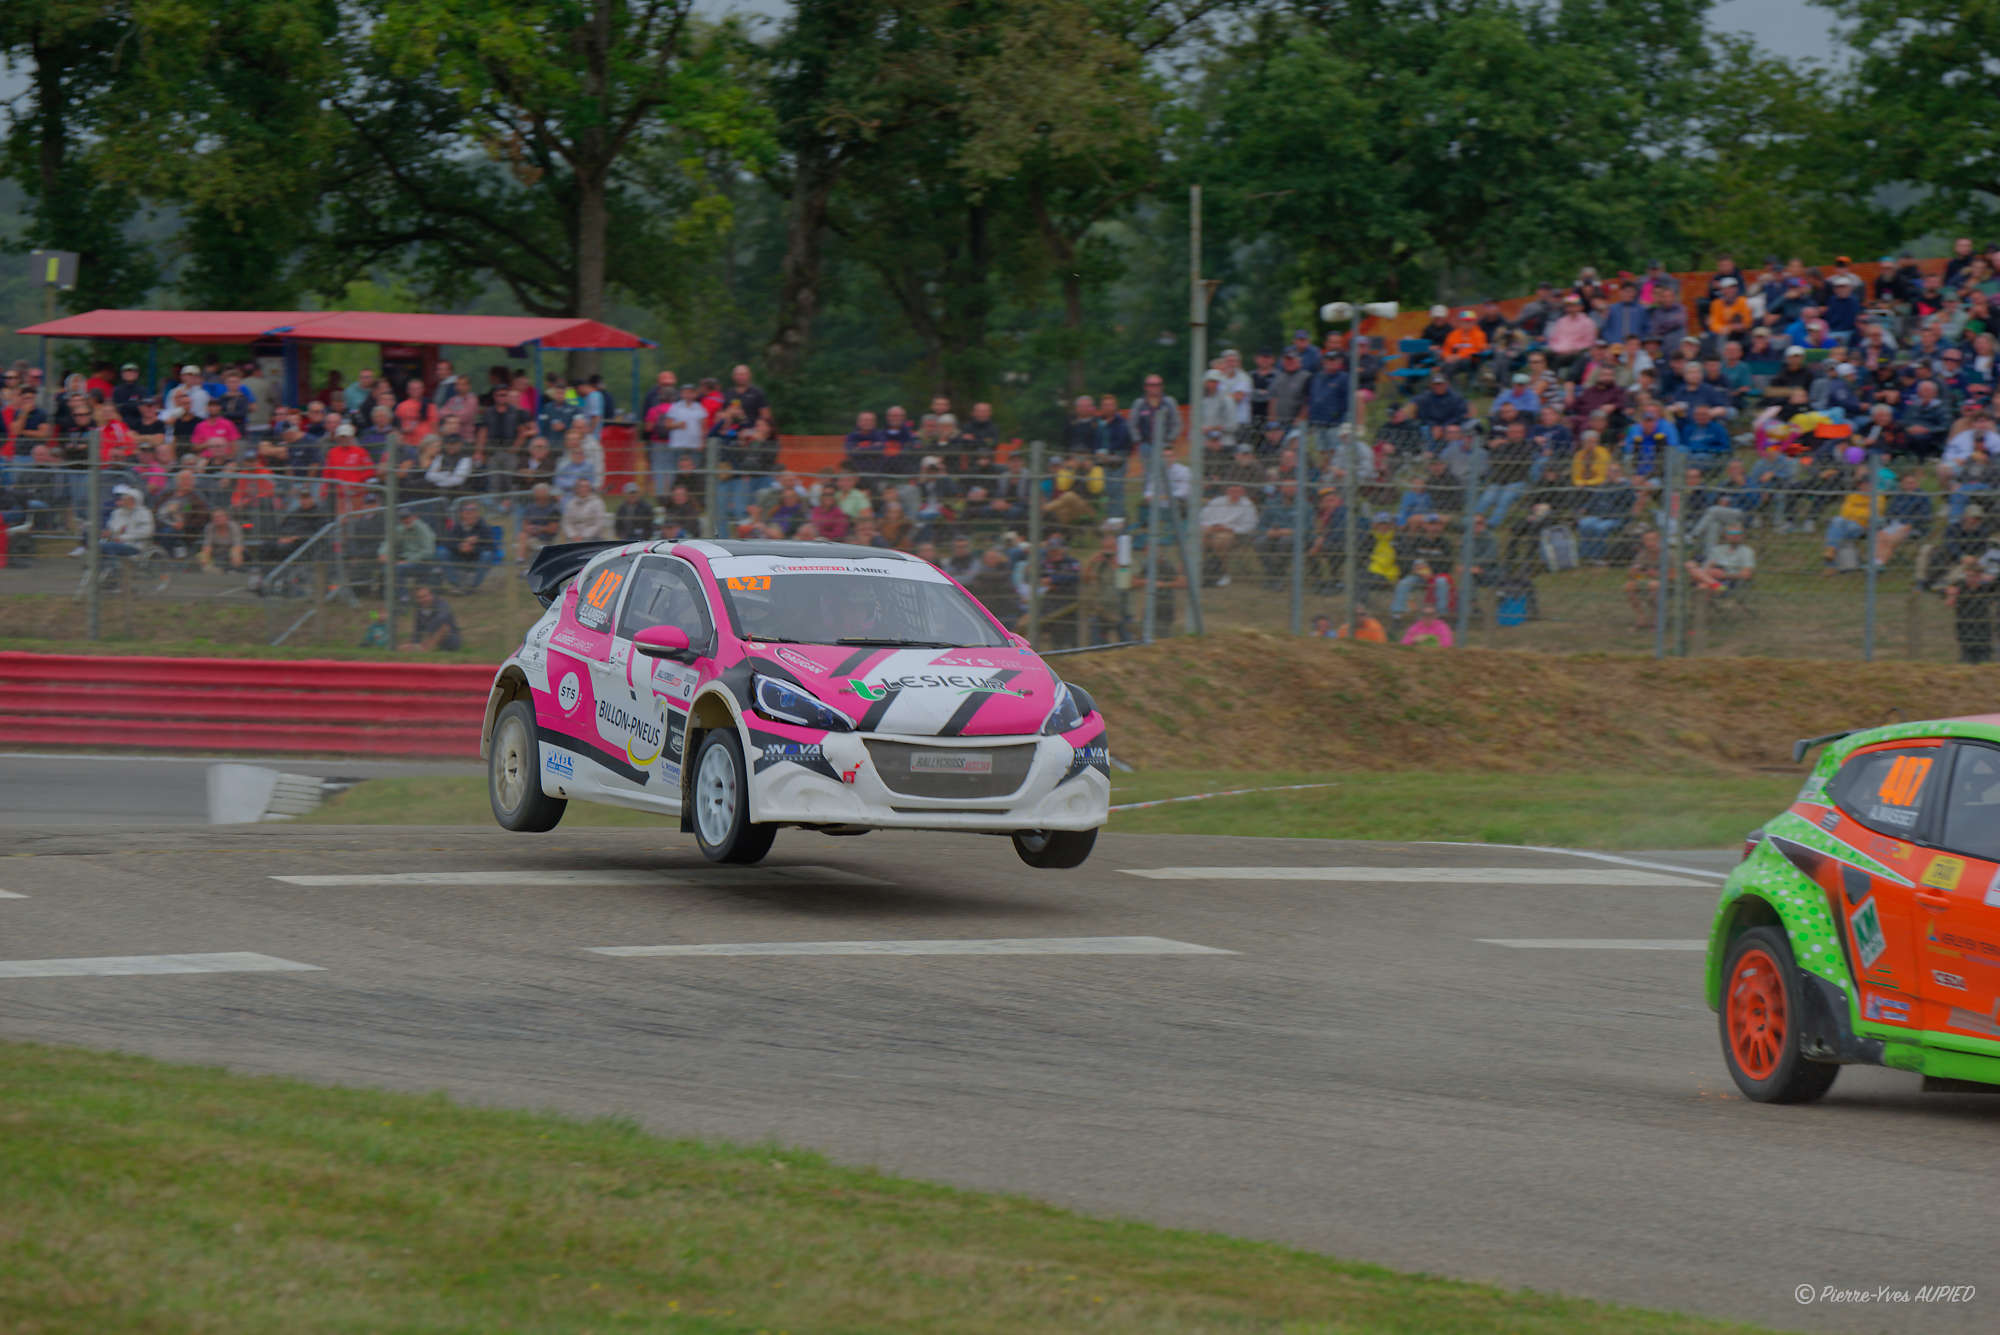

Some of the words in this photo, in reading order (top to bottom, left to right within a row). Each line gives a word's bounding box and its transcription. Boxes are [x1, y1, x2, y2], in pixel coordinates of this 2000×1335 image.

[587, 569, 623, 609] 427
[939, 657, 995, 666] SYS
[881, 674, 1007, 692] LESIEUR
[561, 686, 576, 700] STS
[599, 700, 661, 747] BILLON-PNEUS
